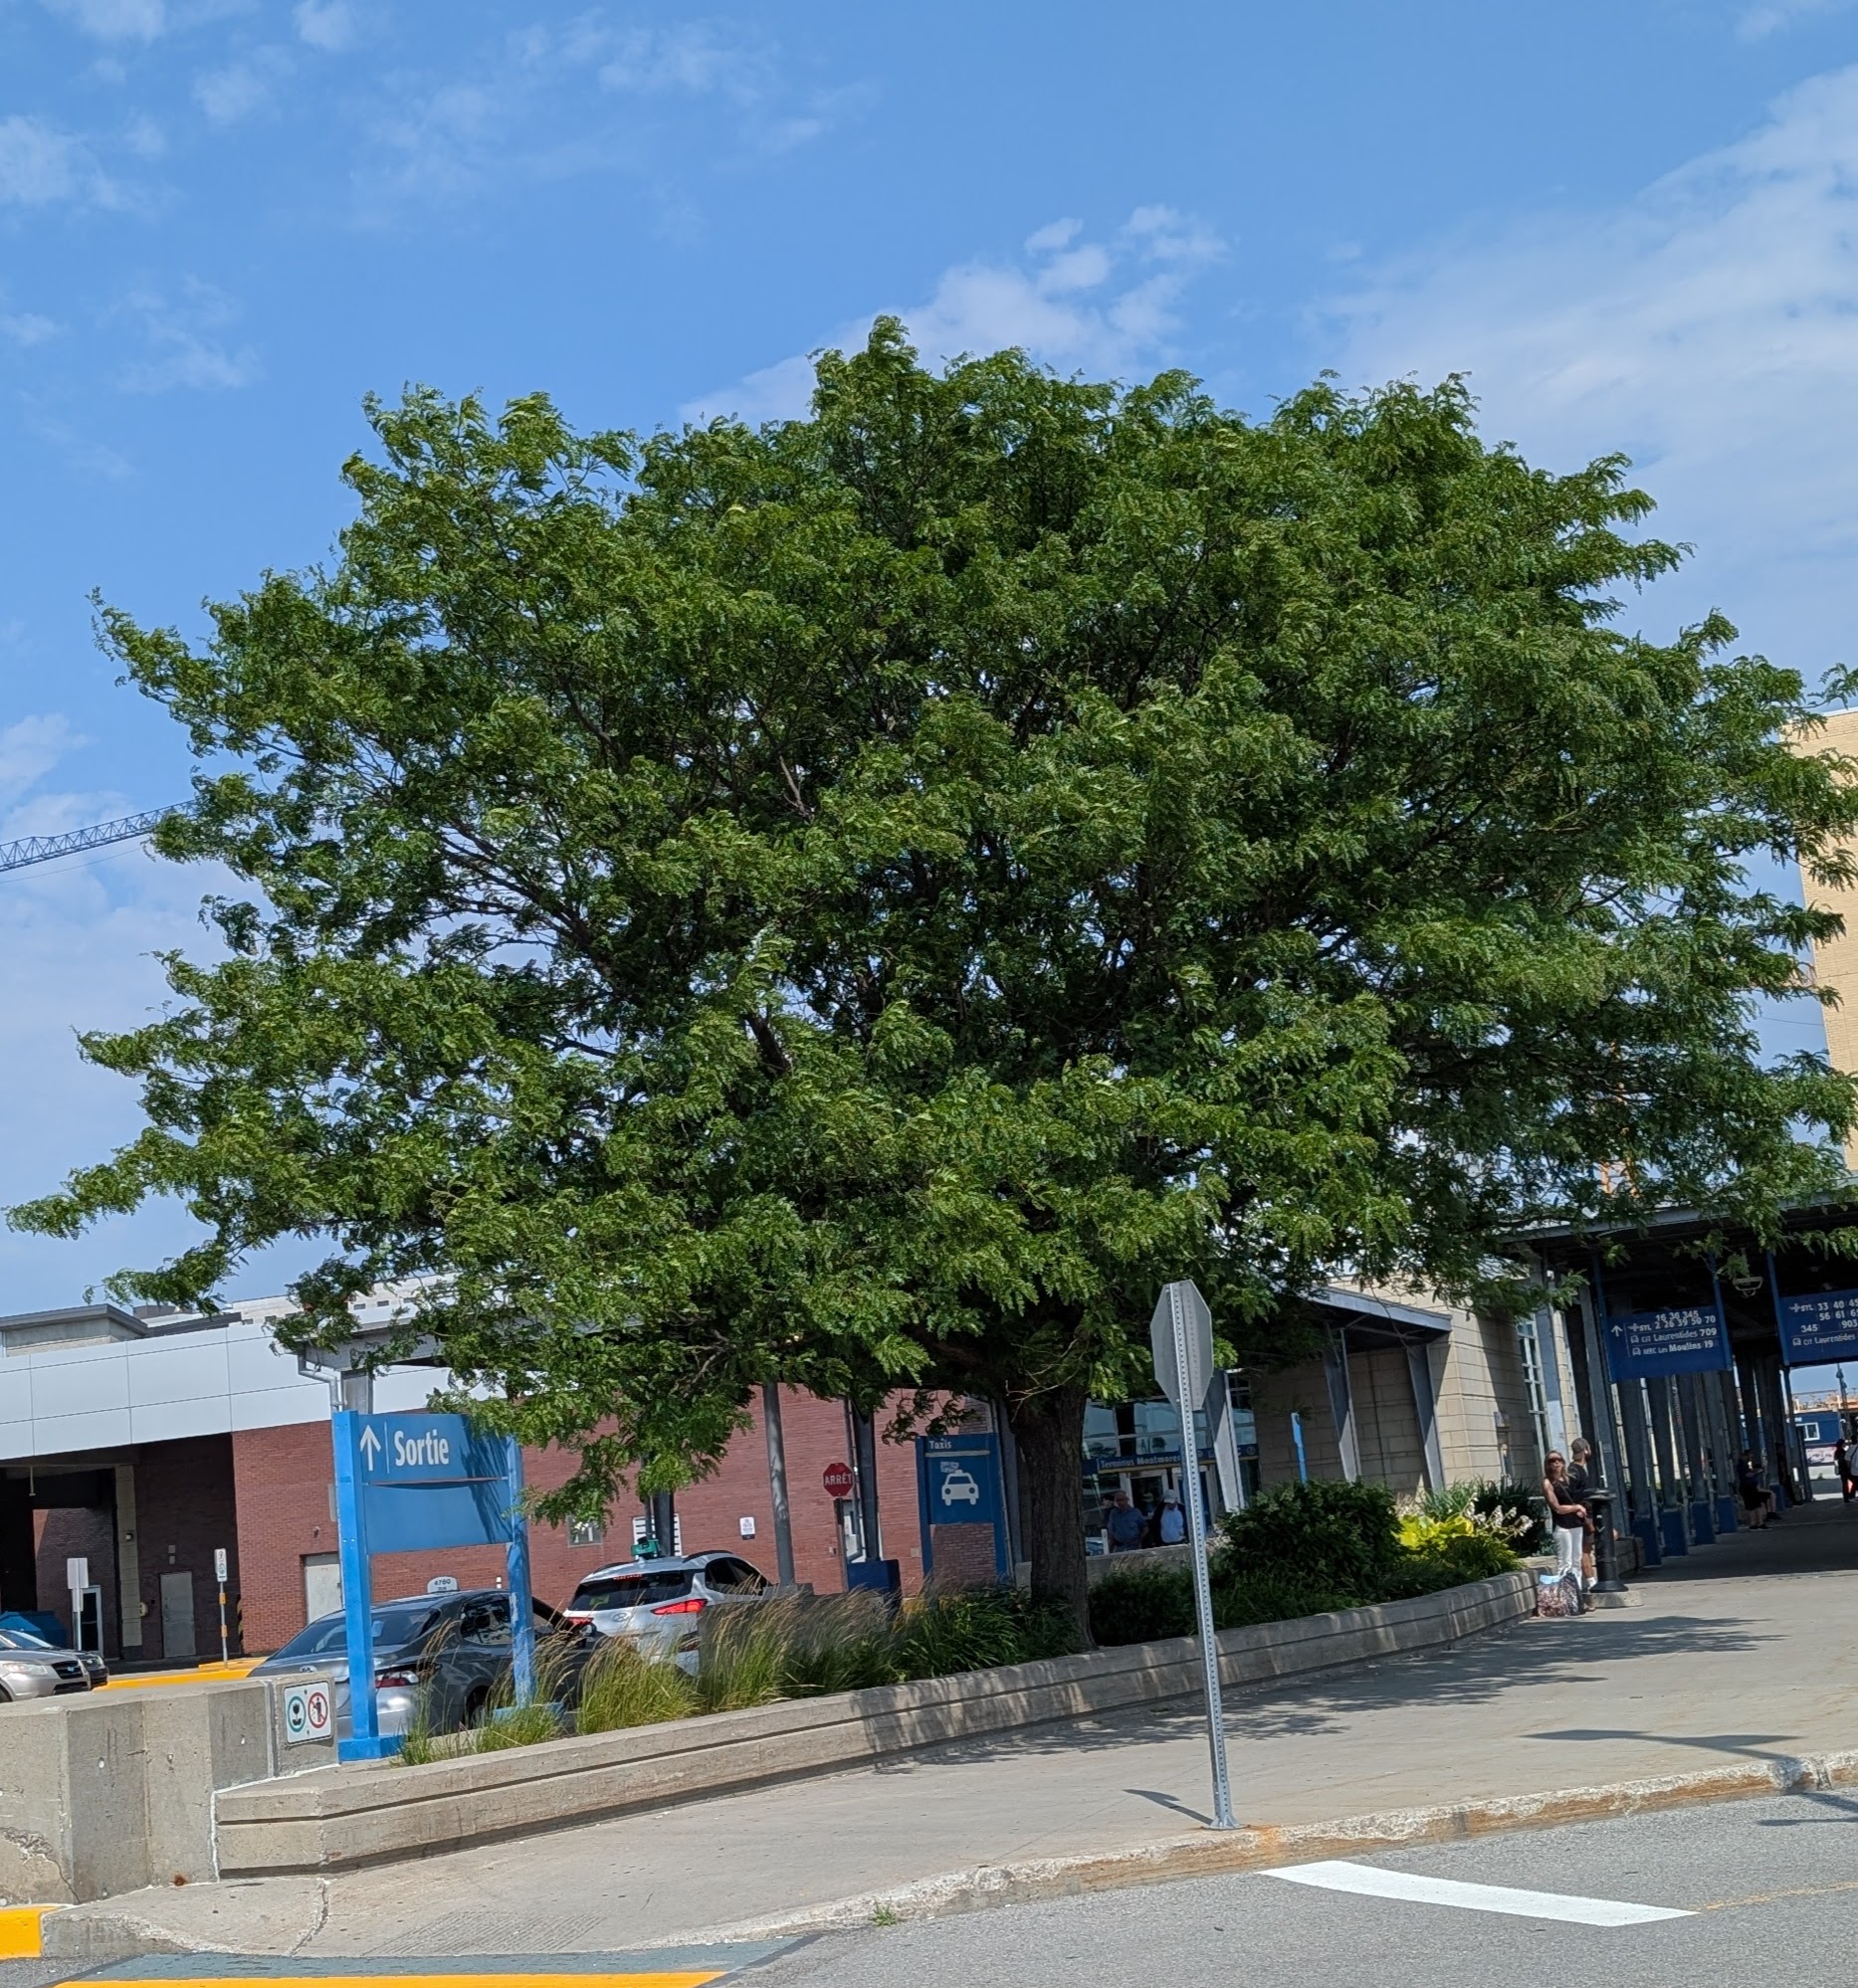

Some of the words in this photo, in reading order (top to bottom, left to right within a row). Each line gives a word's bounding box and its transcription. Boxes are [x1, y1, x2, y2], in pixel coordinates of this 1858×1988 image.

[1817, 1302, 1829, 1311] 33
[1833, 1300, 1845, 1309] 40
[1669, 1311, 1681, 1320] 36
[1682, 1309, 1700, 1318] 345
[1819, 1312, 1831, 1321] 56
[1835, 1310, 1845, 1319] 61
[1850, 1308, 1858, 1317] 6
[1663, 1319, 1675, 1328] 26
[1677, 1318, 1689, 1327] 39
[1691, 1316, 1702, 1325] 50
[1704, 1315, 1716, 1324] 70
[1800, 1323, 1818, 1333] 345
[1841, 1319, 1858, 1329] 903
[1699, 1327, 1718, 1336] 709
[1669, 1341, 1702, 1352] Moulins
[1704, 1339, 1715, 1348] 19
[394, 1428, 450, 1467] Sortie
[929, 1438, 952, 1450] Taxis
[1101, 1459, 1135, 1469] Terminus
[825, 1473, 853, 1487] ARRÊT
